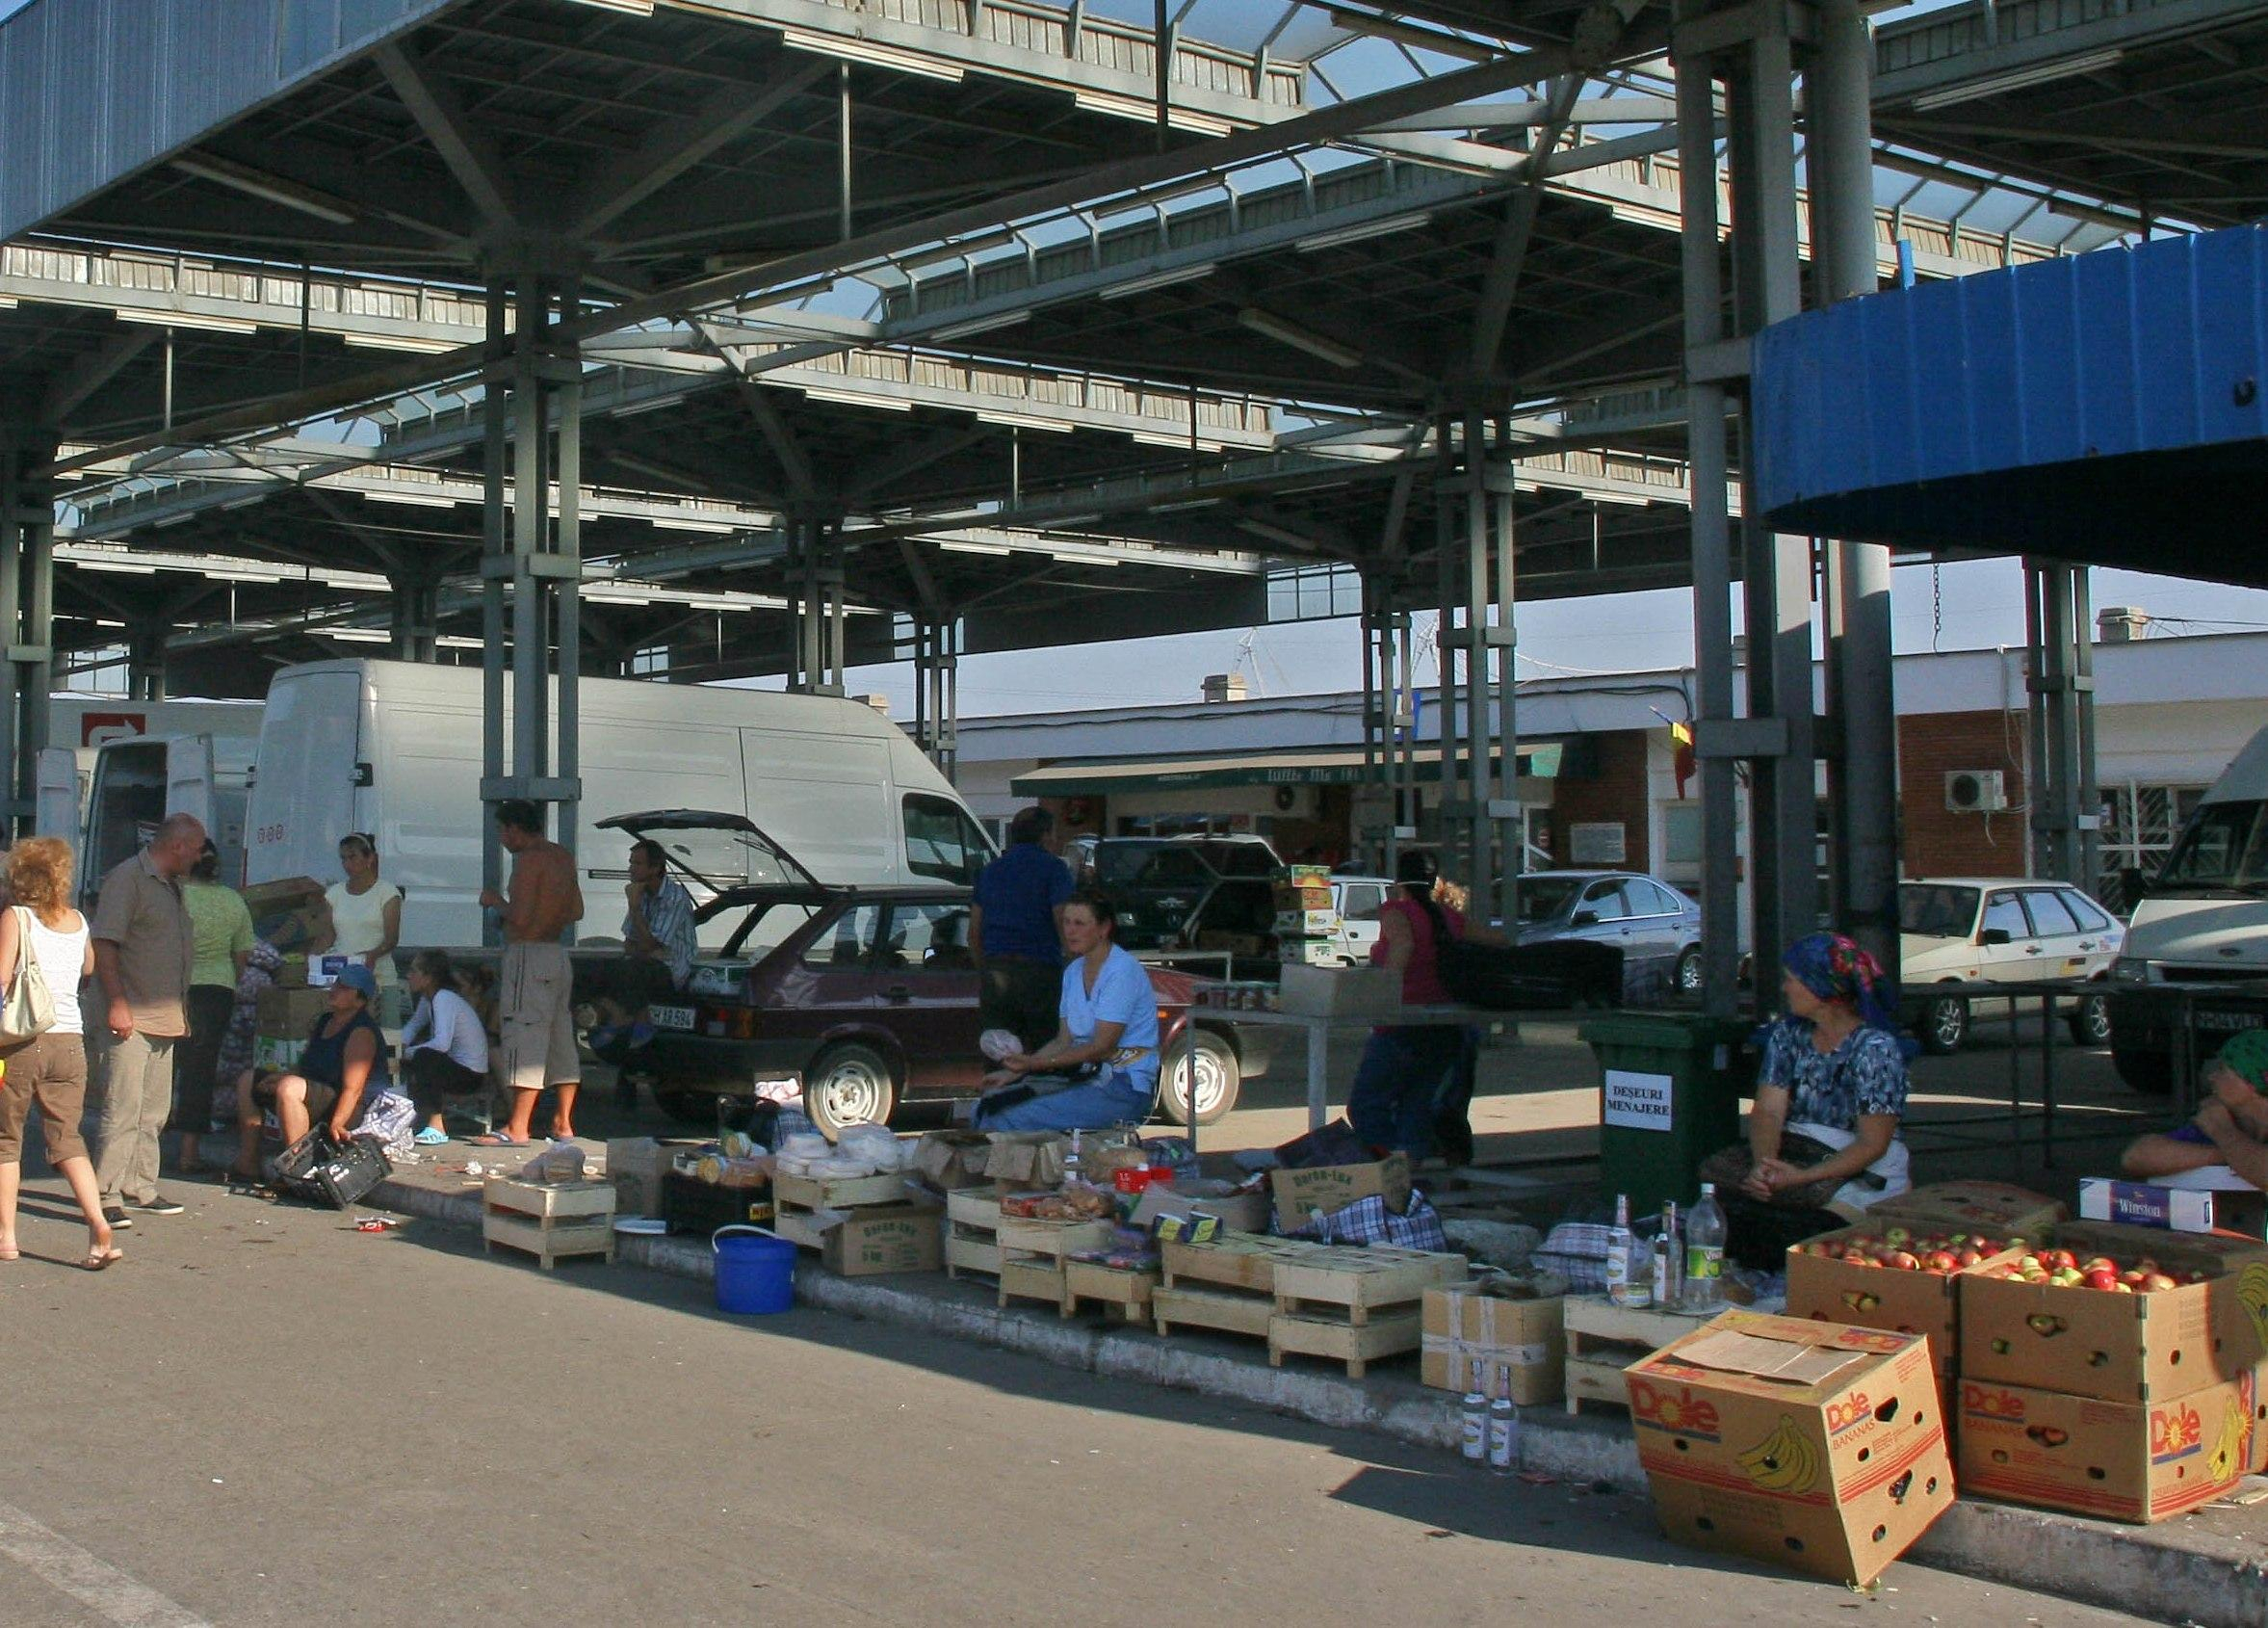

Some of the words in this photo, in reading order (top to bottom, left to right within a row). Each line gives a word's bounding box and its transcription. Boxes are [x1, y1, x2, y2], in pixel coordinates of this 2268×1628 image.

[1607, 1099, 1670, 1116] MENAJERE
[2119, 1198, 2161, 1218] Winston
[1629, 1377, 1719, 1434] Dole
[1826, 1391, 1871, 1432] Dole
[1965, 1385, 2024, 1417] Dole
[1833, 1418, 1876, 1451] BANANAS
[2150, 1402, 2202, 1456] Dole
